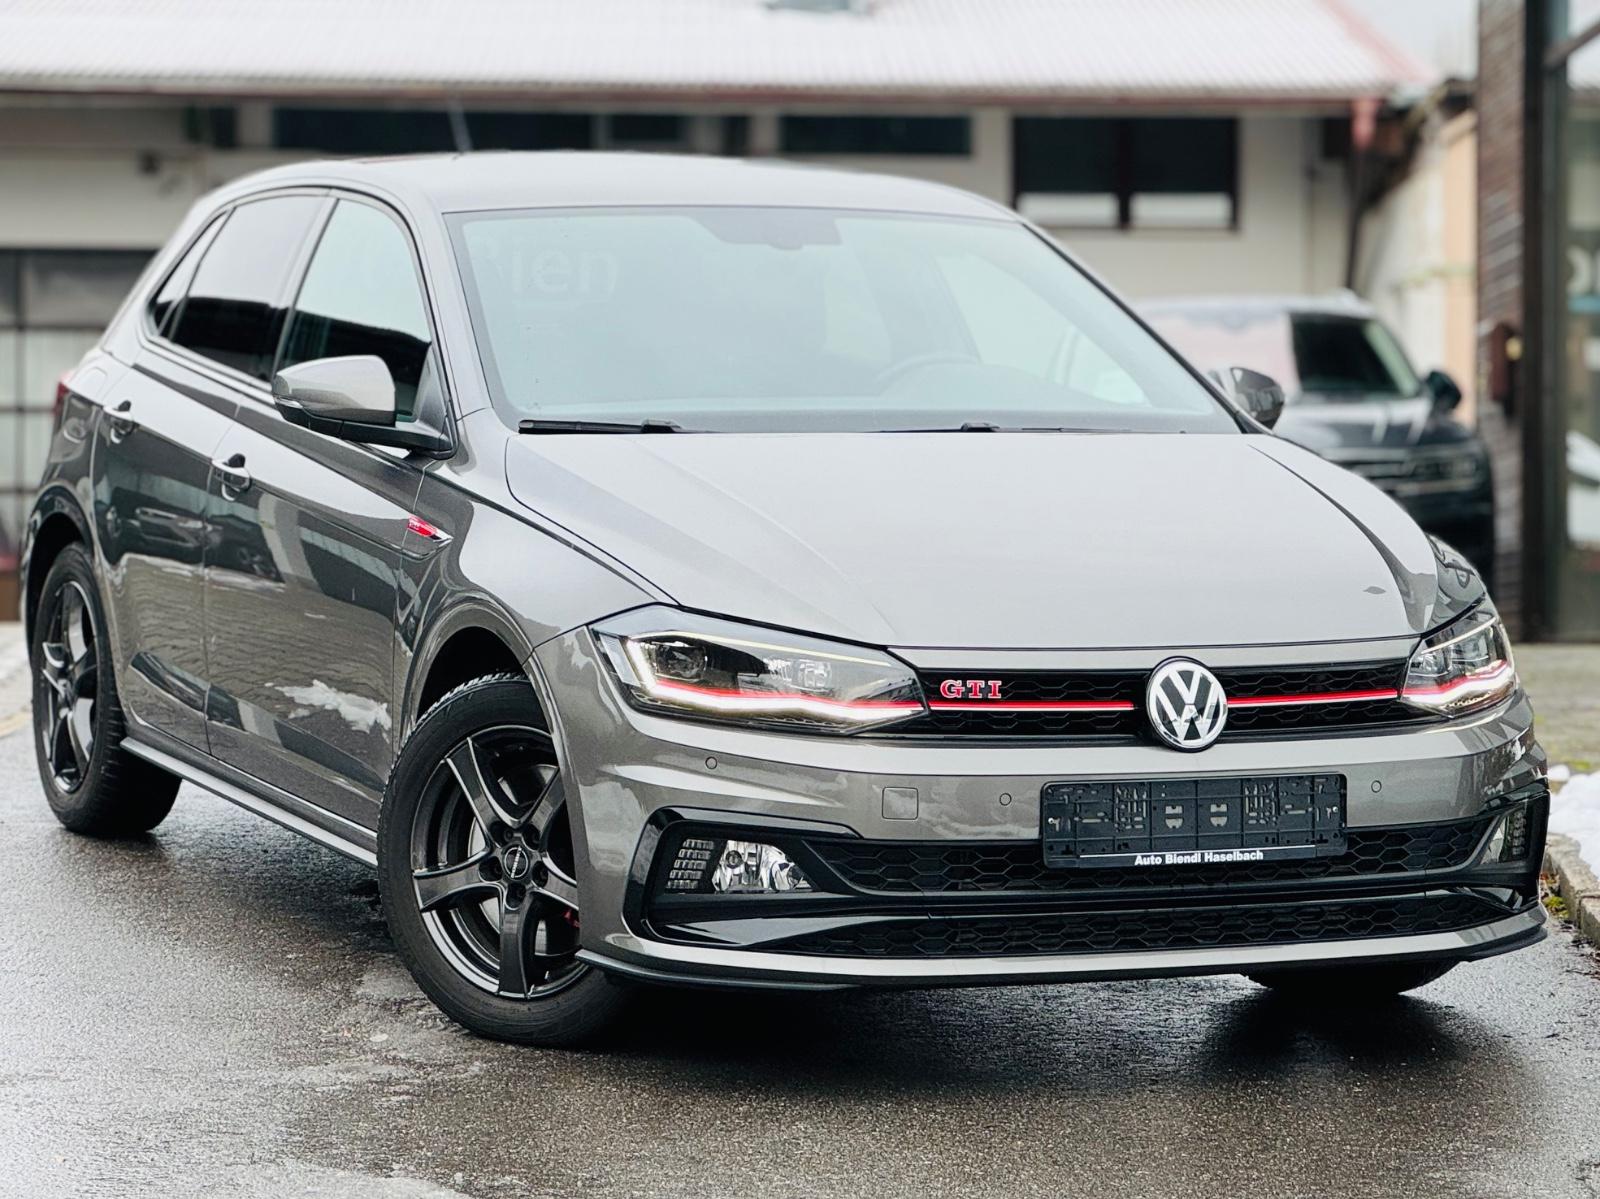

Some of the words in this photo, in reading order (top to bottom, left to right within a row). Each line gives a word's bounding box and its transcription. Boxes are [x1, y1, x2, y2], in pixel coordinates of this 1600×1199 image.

[939, 679, 1003, 699] GTI
[1134, 854, 1163, 866] Auto
[1165, 852, 1202, 864] Biendl
[1204, 850, 1264, 862] Haselbach
